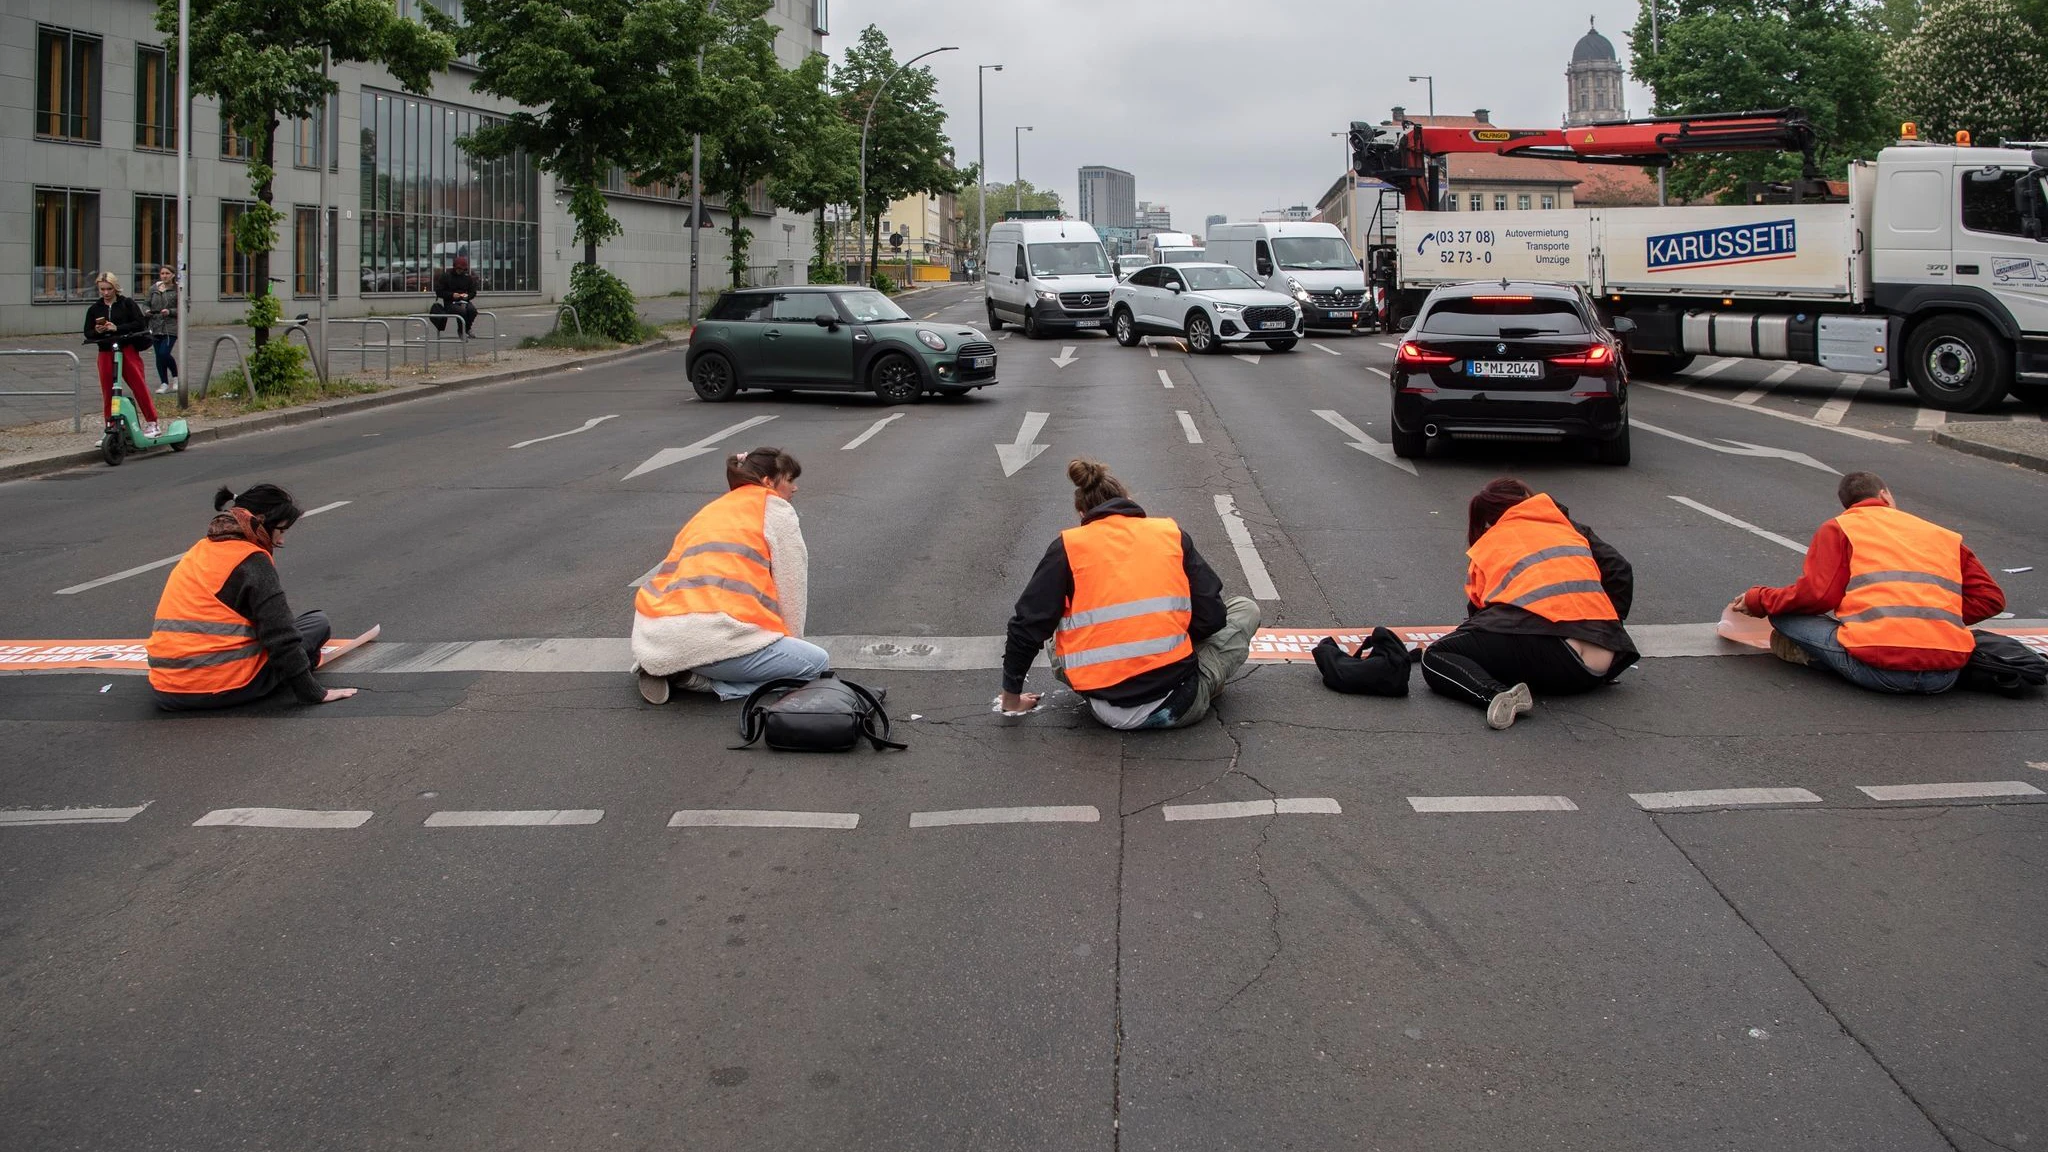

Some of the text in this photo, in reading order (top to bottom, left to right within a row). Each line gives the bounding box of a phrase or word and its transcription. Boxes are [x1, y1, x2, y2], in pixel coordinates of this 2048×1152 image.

[1435, 230, 1496, 246] (03 37 08)
[1505, 229, 1569, 239] Autovermietung
[1526, 241, 1570, 251] Transporte
[1649, 224, 1793, 265] KARUSSEIT
[1440, 251, 1455, 263] 52
[1458, 251, 1473, 263] 73
[1484, 251, 1492, 263] 0
[1536, 254, 1570, 265] Umzüge
[1925, 263, 1949, 271] 370
[1475, 363, 1536, 374] B MI 2044
